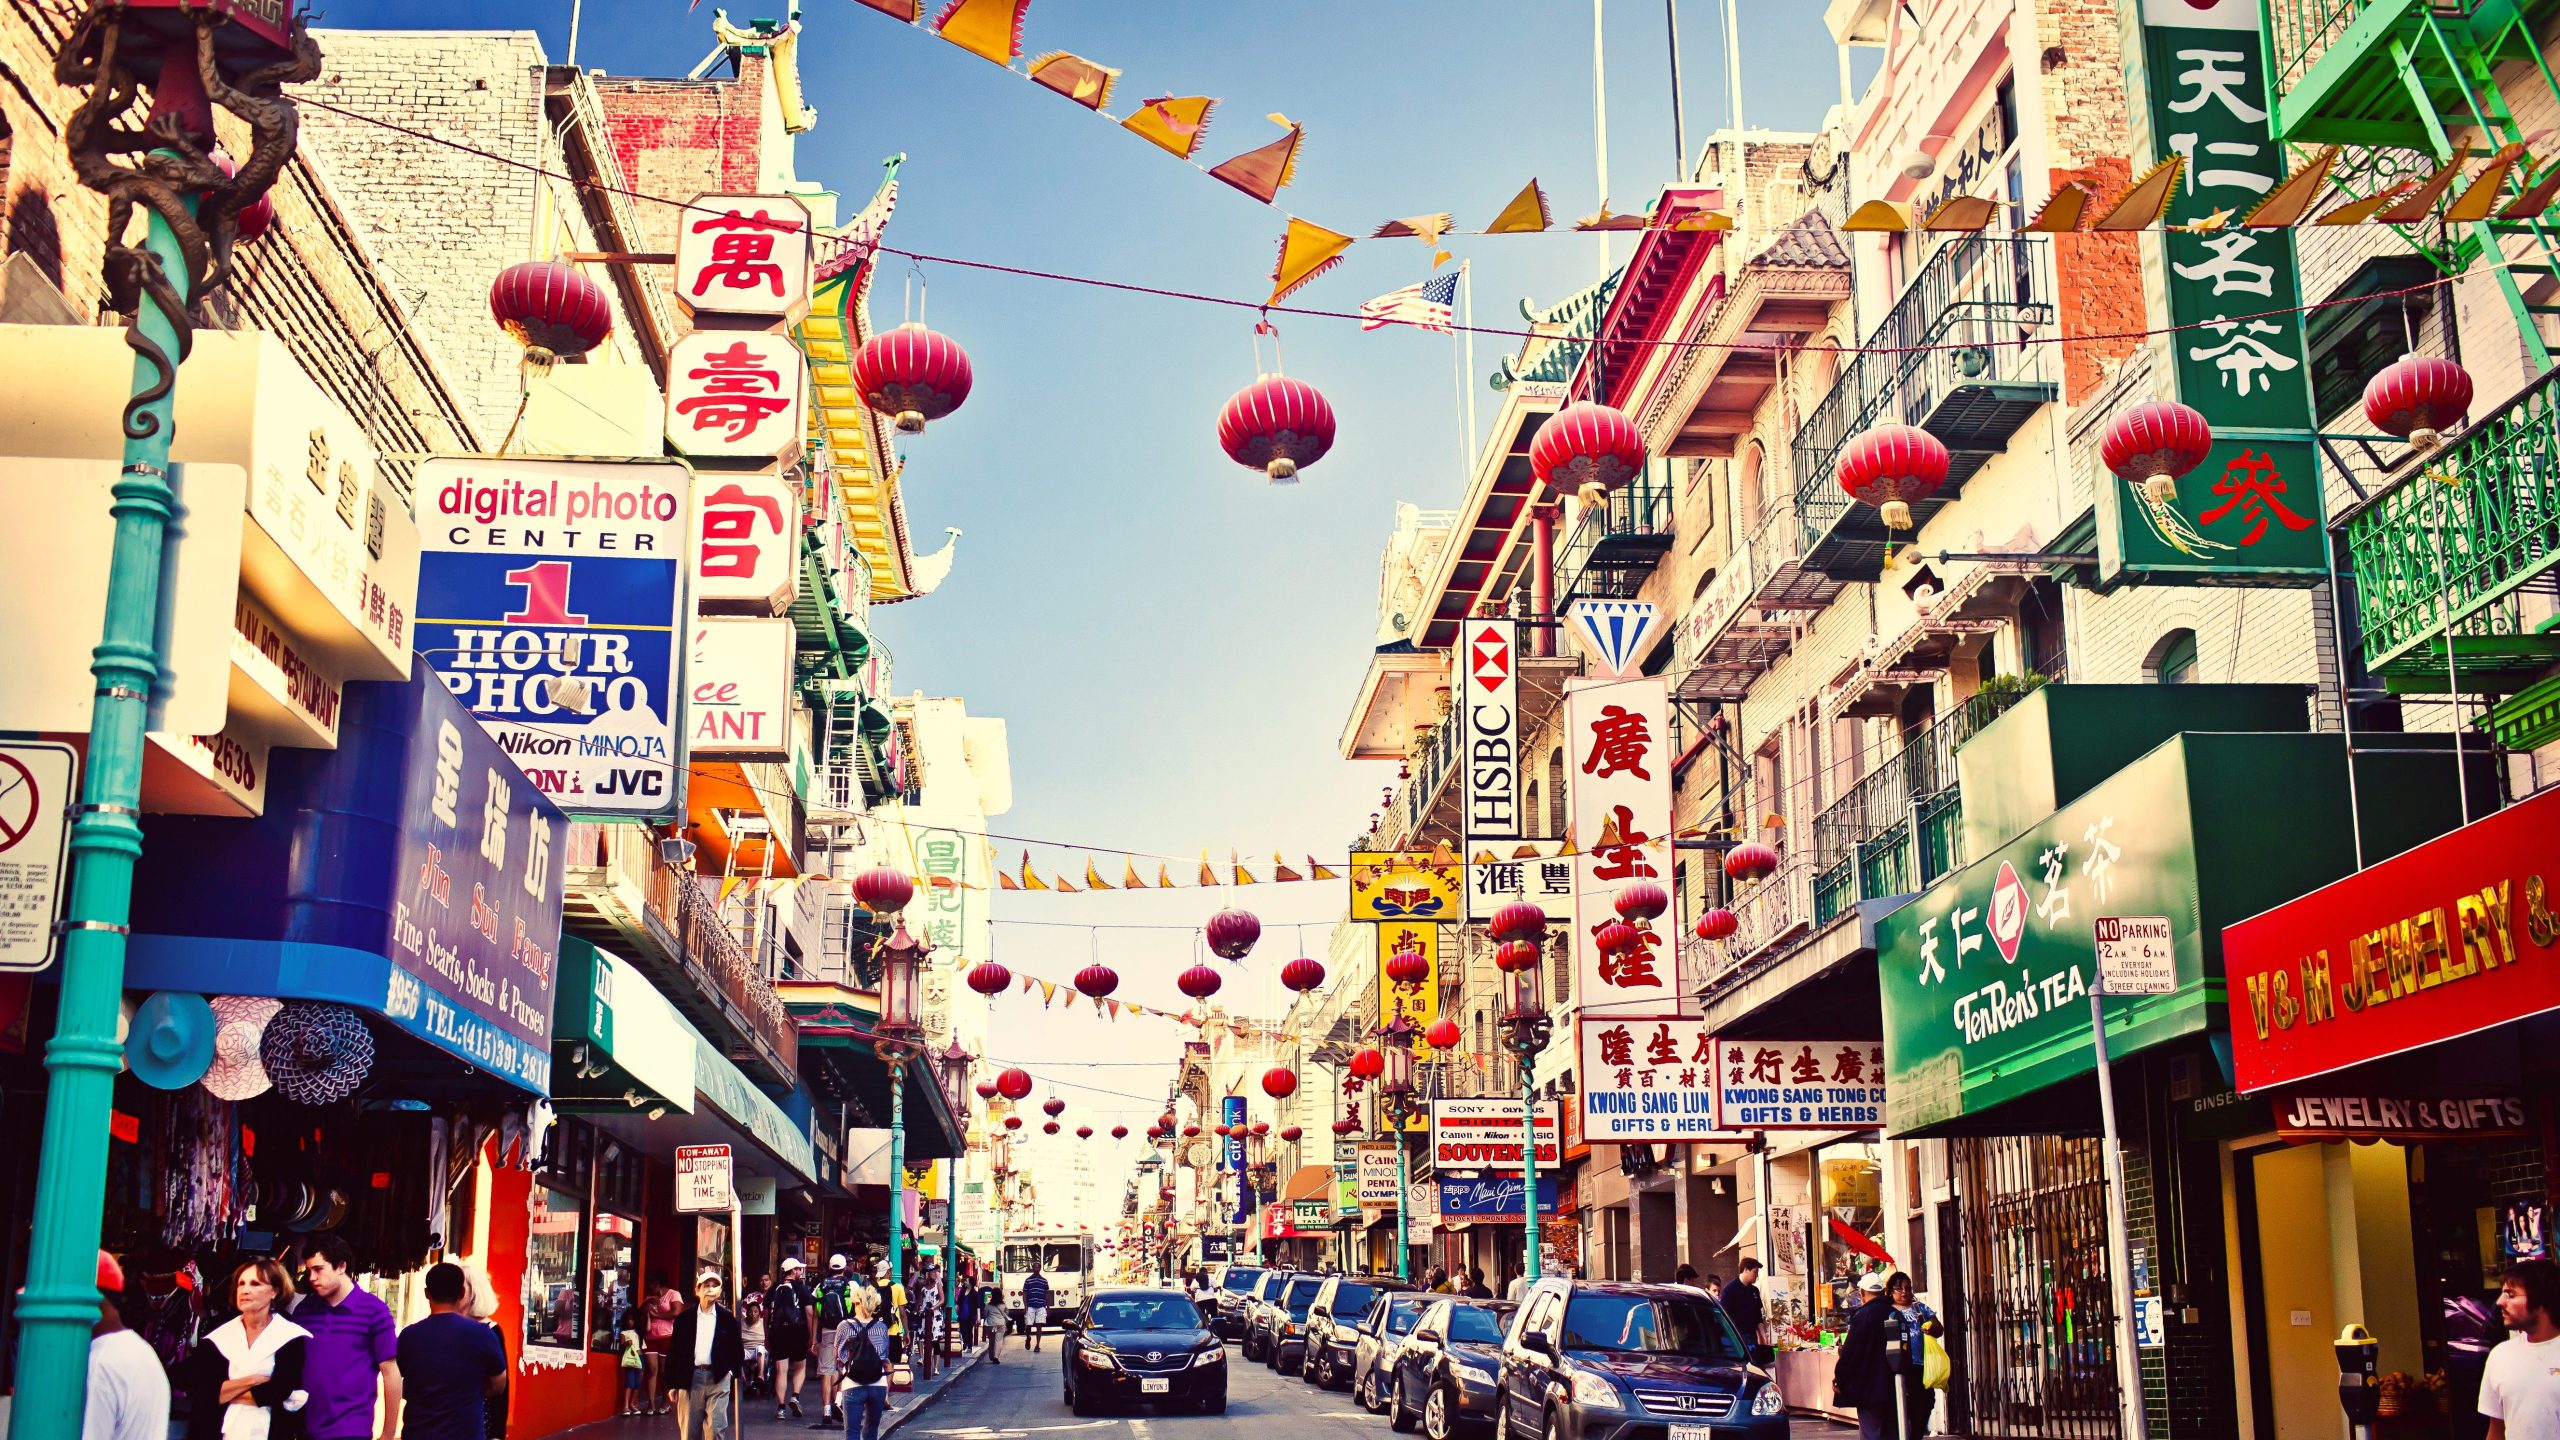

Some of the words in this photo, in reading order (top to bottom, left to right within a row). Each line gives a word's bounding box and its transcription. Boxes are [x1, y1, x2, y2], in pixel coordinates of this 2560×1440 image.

[2167, 48, 2299, 398] 天仁茗茶
[438, 477, 557, 525] digital
[565, 481, 678, 526] photo
[448, 526, 655, 552] CENTER
[504, 561, 589, 627] 1
[450, 628, 634, 674] HOUR
[435, 670, 649, 716] PHOTO
[497, 731, 572, 756] Nikon
[1473, 704, 1512, 829] HSBC
[595, 769, 663, 797] JVC
[420, 842, 450, 909] Jin
[470, 882, 500, 945] Sui
[511, 915, 552, 991] Fang
[2098, 920, 2119, 939] NO
[2121, 924, 2168, 939] PARKING
[1919, 906, 1983, 986] 天仁
[2104, 944, 2113, 958] 2
[2143, 944, 2151, 958] 6
[2120, 961, 2153, 969] EVERYDAY
[2245, 971, 2269, 1041] V
[2272, 969, 2300, 1030] &
[2299, 949, 2336, 1025] M
[2340, 878, 2516, 1012] JEWELRY
[2524, 874, 2560, 948] &
[393, 901, 424, 957] Fine
[425, 927, 465, 993] Scarfs,
[465, 957, 496, 1007] Socks
[498, 977, 509, 1013] &
[510, 984, 545, 1036] Purses
[2104, 970, 2139, 978] INCLUDING
[2140, 970, 2171, 978] HOLIDAYS
[2040, 964, 2086, 1013] TEA
[2109, 982, 2134, 991] STREET
[2135, 982, 2170, 991] CLEANING
[1588, 1091, 1637, 1115] KWONG
[1641, 1091, 1678, 1114] SANG
[1724, 1088, 1781, 1104] KWONG
[1782, 1088, 1824, 1104] SANG
[1826, 1087, 1867, 1103] TONG
[1740, 1106, 1792, 1123] GIFTS
[1800, 1107, 1812, 1122] &
[1817, 1106, 1878, 1122] HERBS
[2287, 1096, 2419, 1128] JEWELRY
[2418, 1101, 2438, 1129] &
[2439, 1096, 2526, 1130] GIFTS
[1611, 1117, 1655, 1132] GIFTS
[1660, 1117, 1670, 1132] &
[1229, 1110, 1242, 1161] citink
[1440, 1130, 1473, 1139] Canon
[1483, 1131, 1510, 1139] Nikon
[681, 1147, 725, 1157] TOW-AWAY
[1342, 1147, 1355, 1155] WO
[1364, 1154, 1402, 1165] Cano
[1438, 1143, 1558, 1162] SOUVENRS
[679, 1157, 692, 1172] NO
[694, 1159, 727, 1172] STOPPING
[1364, 1167, 1406, 1177] MINOL
[693, 1174, 714, 1185] ANY
[1367, 1180, 1397, 1188] PENTA
[693, 1186, 715, 1198] TIME
[1361, 1190, 1407, 1198] OLYMPS
[1443, 1185, 1471, 1195] zippo
[1294, 1205, 1318, 1217] TEA
